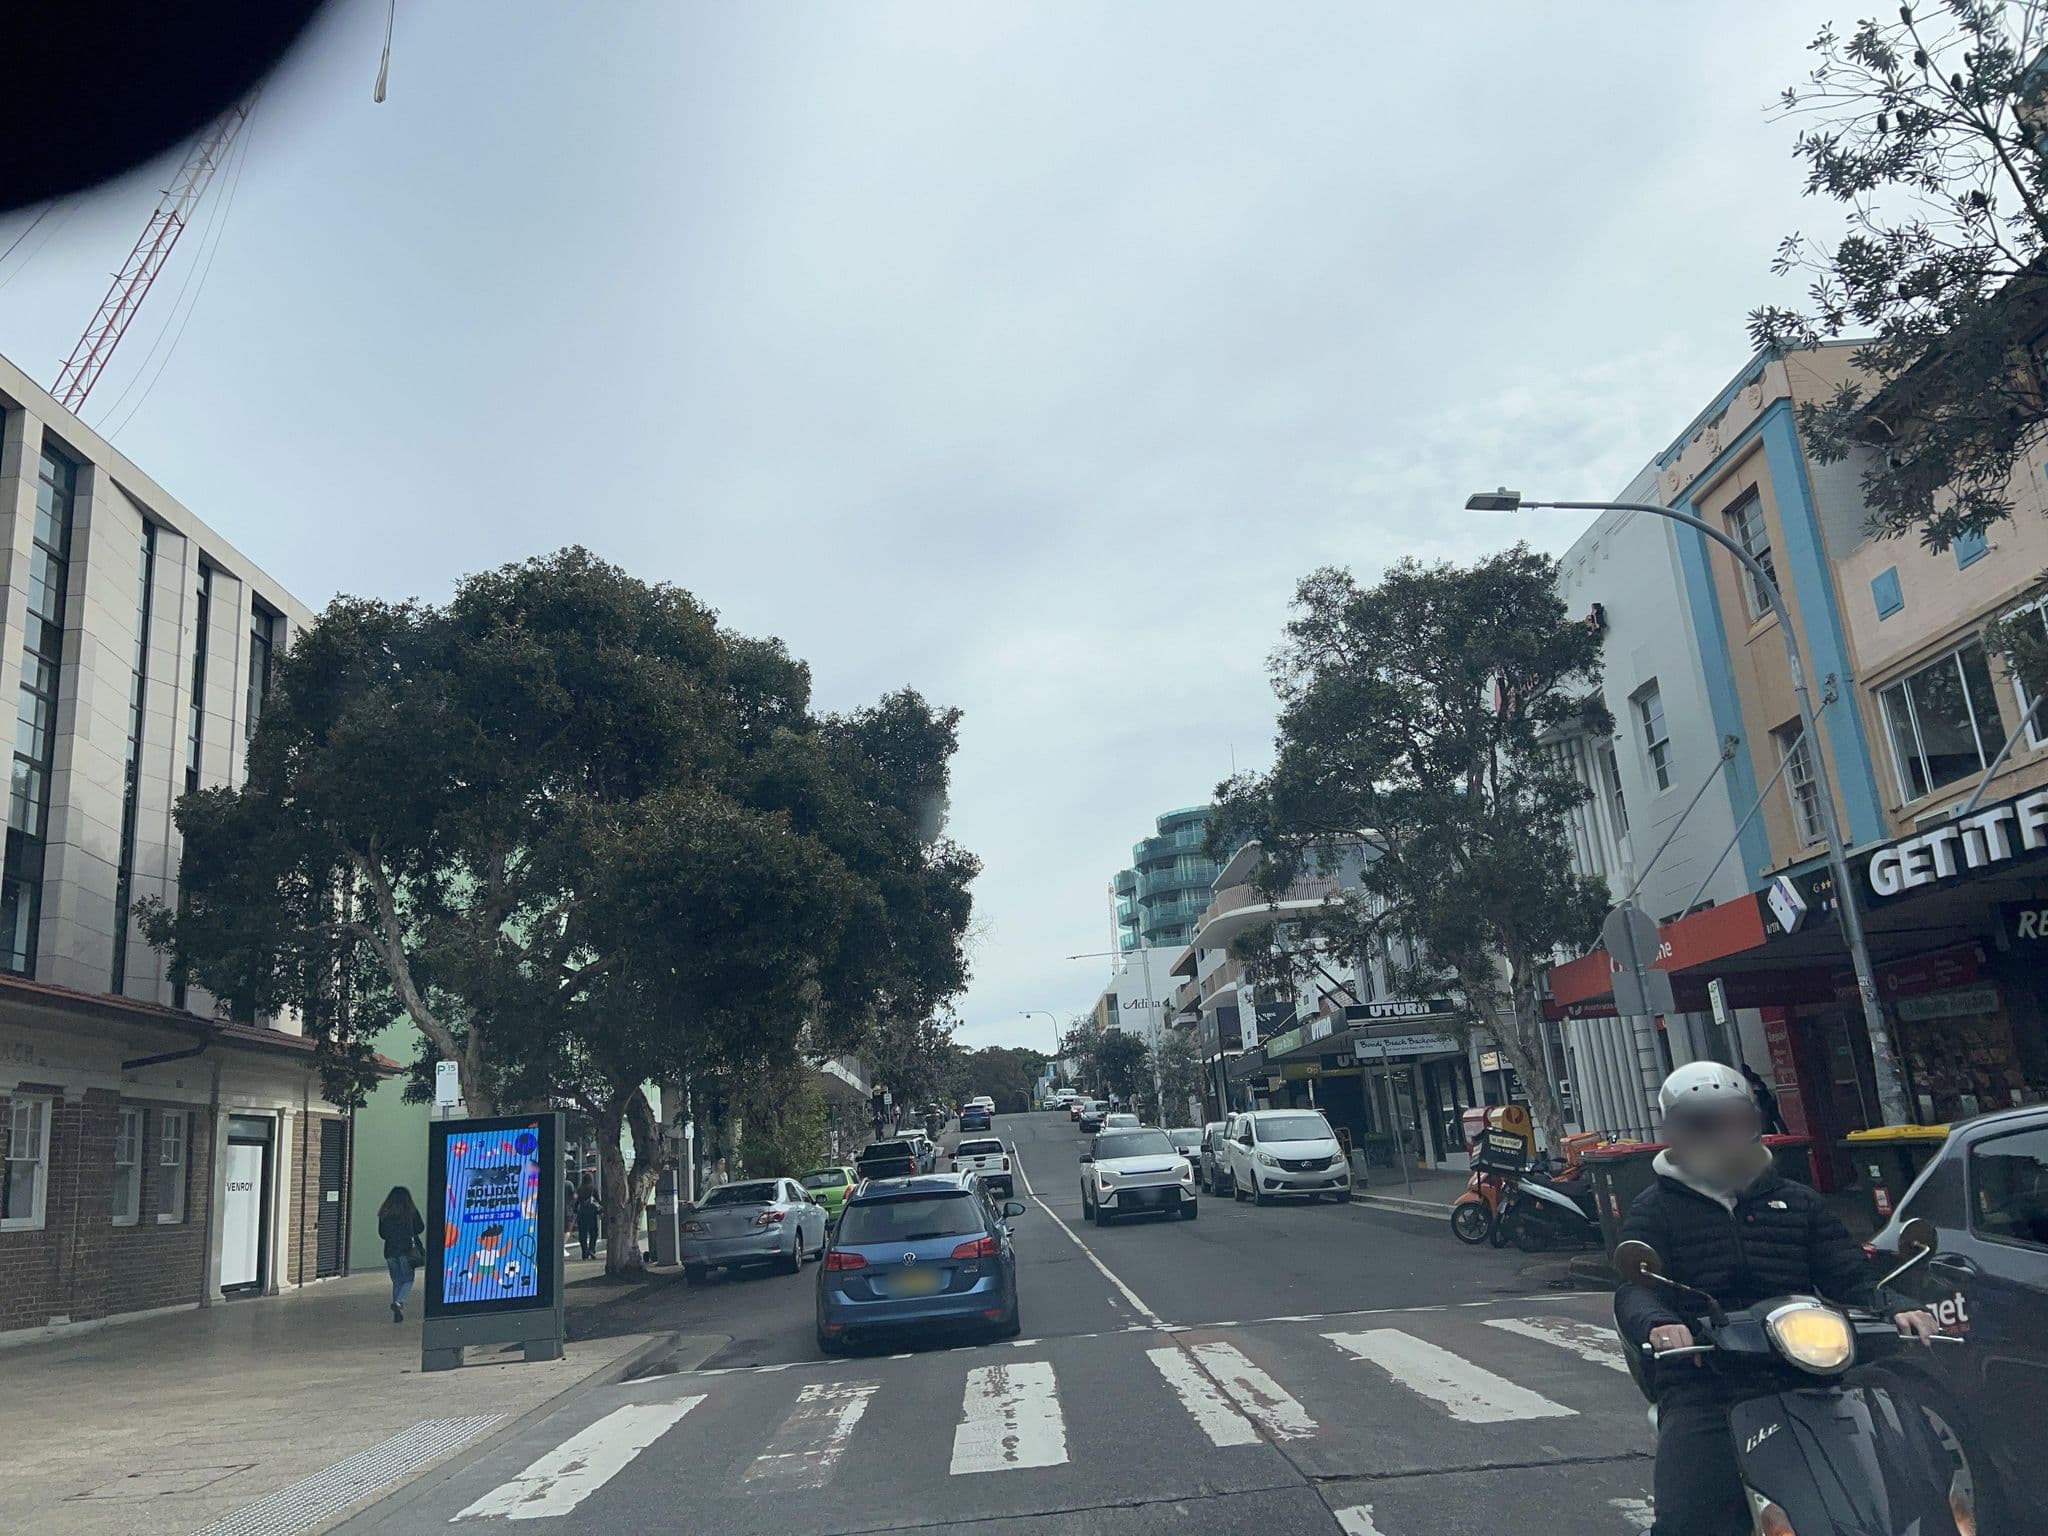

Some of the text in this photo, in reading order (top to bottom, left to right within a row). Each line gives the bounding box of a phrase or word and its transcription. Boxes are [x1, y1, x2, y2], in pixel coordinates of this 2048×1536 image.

[2016, 790, 2048, 851] F
[2017, 909, 2048, 940] RE
[227, 1181, 254, 1193] VENROY
[1743, 1422, 1783, 1454] like
